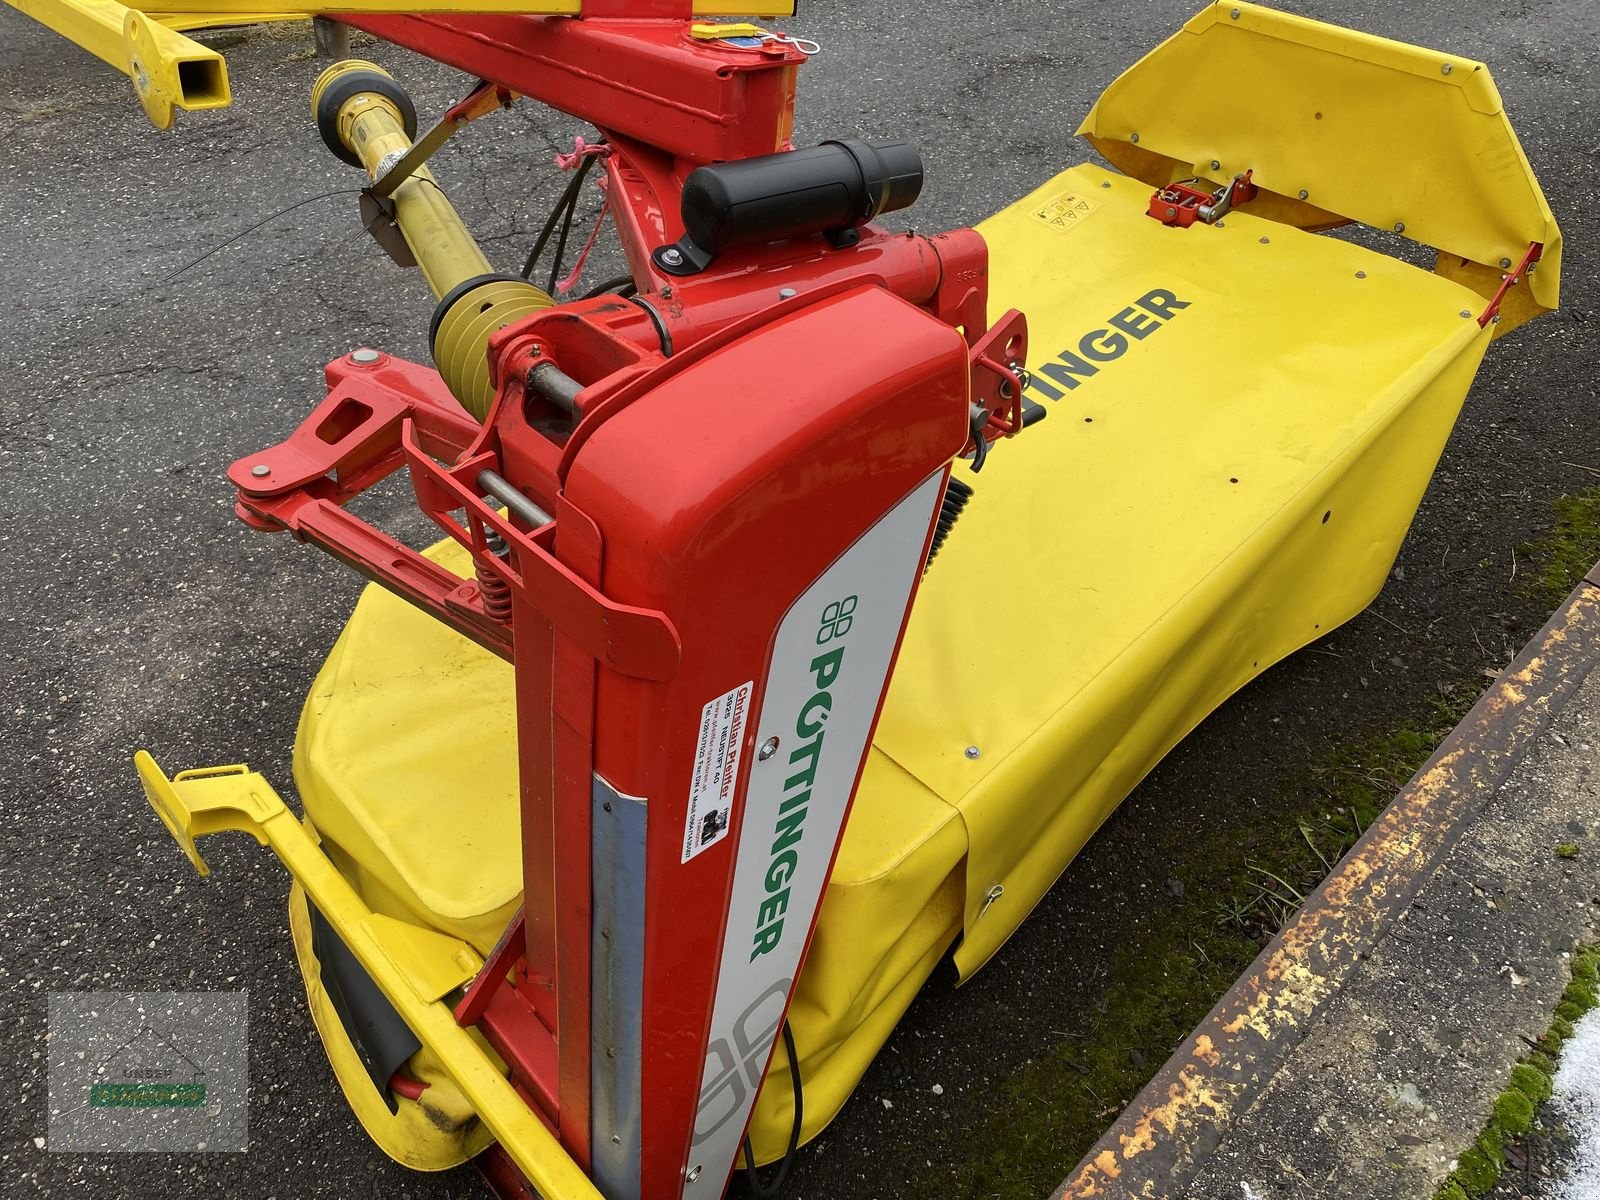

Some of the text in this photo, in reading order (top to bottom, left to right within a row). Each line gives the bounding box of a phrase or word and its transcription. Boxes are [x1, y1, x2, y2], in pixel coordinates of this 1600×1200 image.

[702, 700, 721, 792] www.pfeiffer-traktoren.at
[704, 704, 713, 718] Tel.
[713, 693, 734, 784] 3925 NEUSTIFT 40
[721, 687, 748, 799] Christian Pfeiffer
[695, 816, 703, 848] Traktoren
[749, 646, 845, 964] PÖTTINGER
